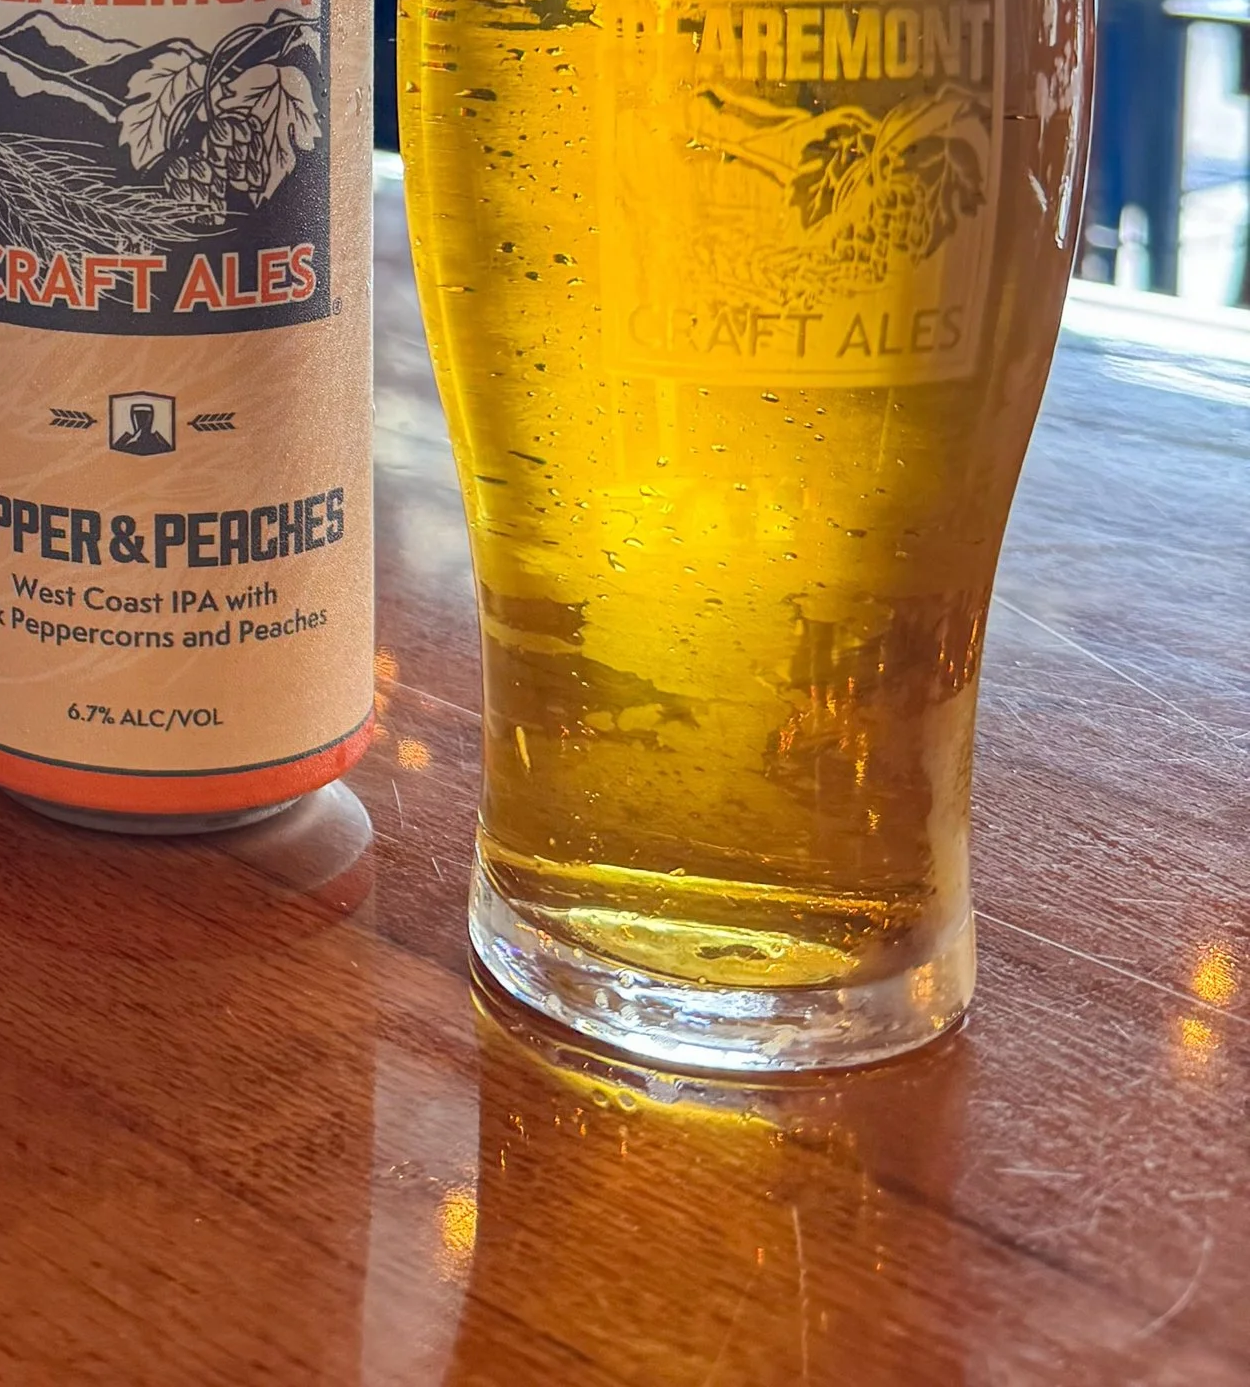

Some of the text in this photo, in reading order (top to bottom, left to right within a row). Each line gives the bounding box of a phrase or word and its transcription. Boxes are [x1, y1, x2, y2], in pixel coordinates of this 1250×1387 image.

[173, 242, 317, 312] ALES
[836, 305, 963, 359] ALES
[12, 573, 278, 614] West Coast IPA with
[11, 611, 174, 648] Peppercorns
[182, 624, 231, 647] and
[239, 606, 328, 644] Peaches
[67, 702, 224, 732] 6.7% ALC/VOL
